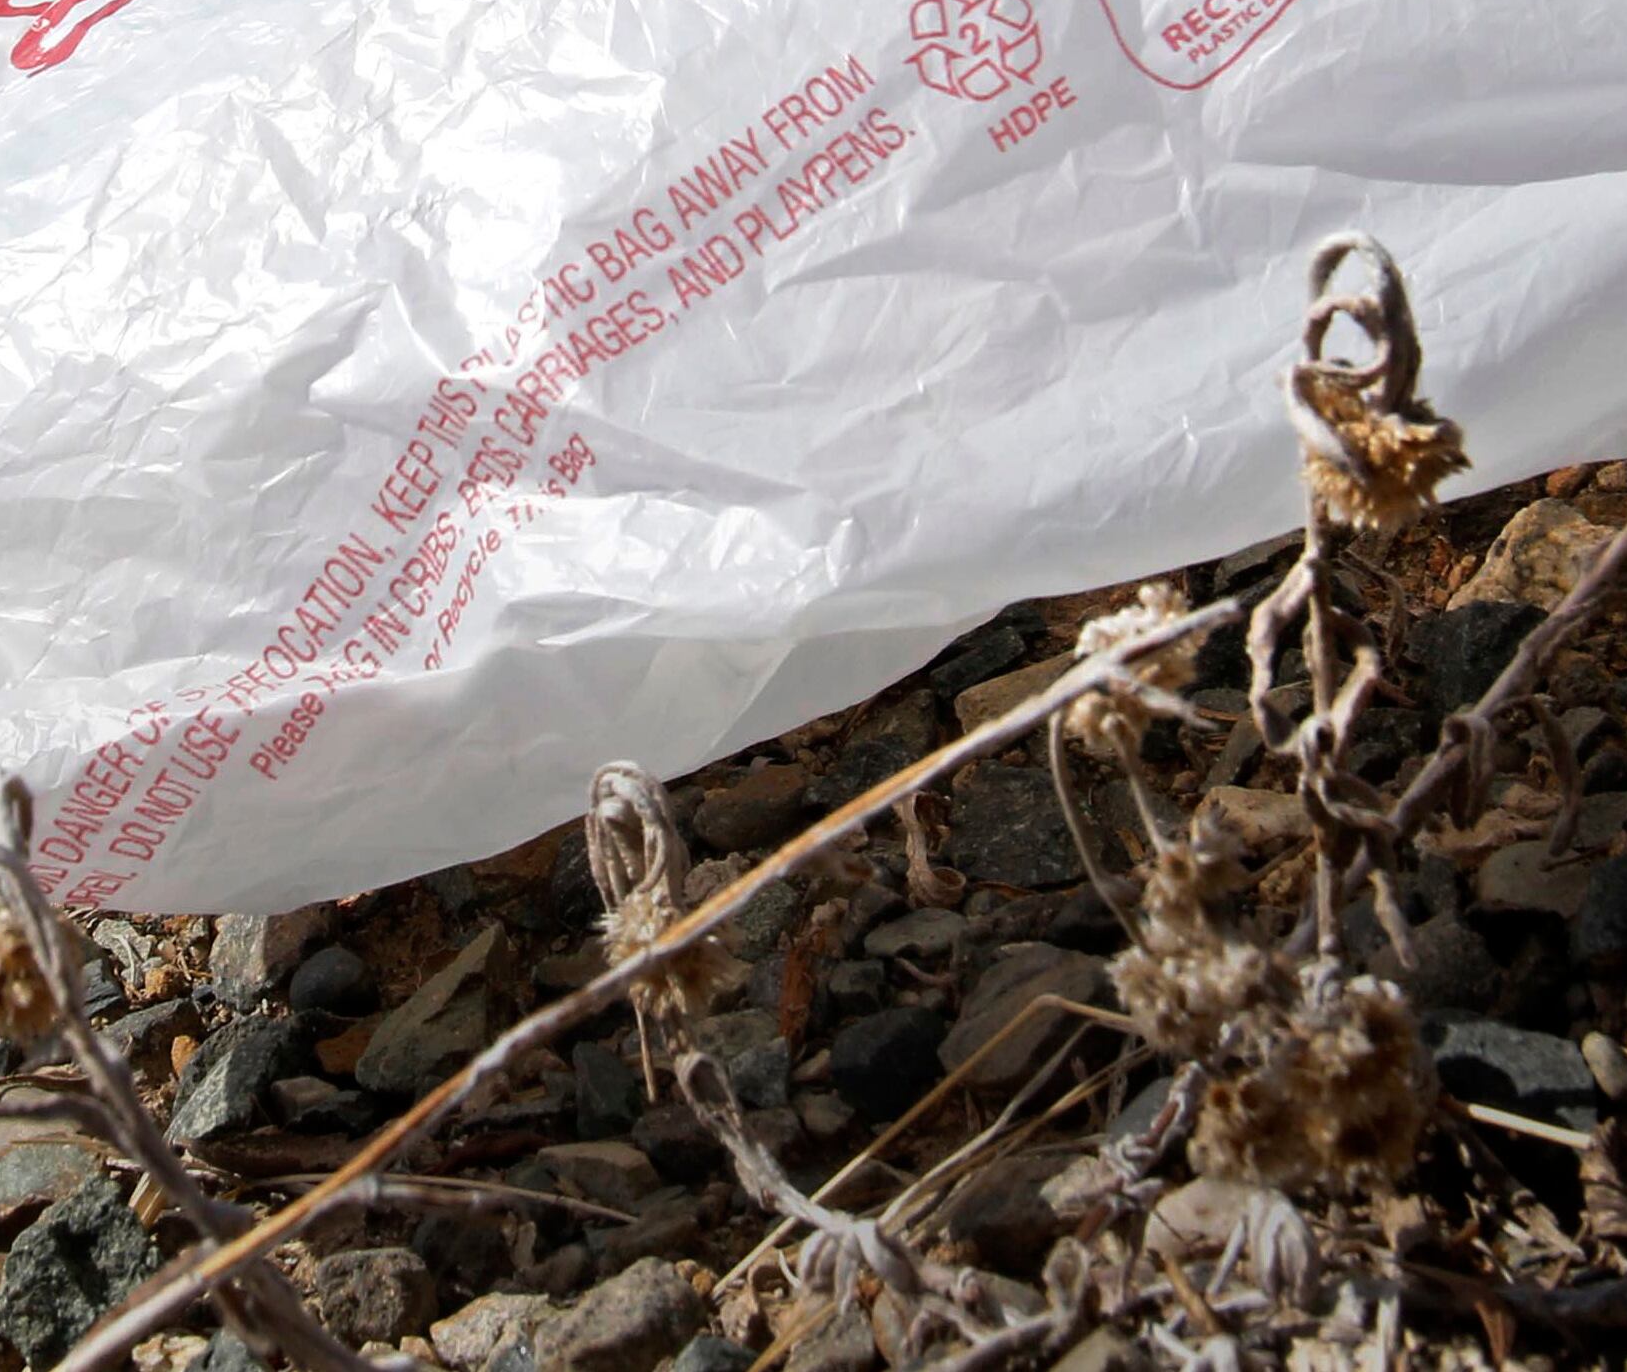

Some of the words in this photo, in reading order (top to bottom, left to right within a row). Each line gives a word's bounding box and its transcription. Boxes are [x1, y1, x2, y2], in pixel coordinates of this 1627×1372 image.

[958, 22, 992, 56] 2
[1187, 6, 1261, 63] PLASTIC
[986, 76, 1079, 154] HDPE
[734, 106, 917, 258] PLAYPENS.
[667, 234, 745, 310] AND
[493, 289, 680, 447] CARRIAGES,
[39, 740, 144, 864] DANGER
[371, 439, 443, 535] KEEP
[417, 377, 477, 450] THIS
[586, 208, 676, 283] BAG
[667, 126, 770, 231] AWAY
[762, 53, 876, 151] FROM
[249, 692, 325, 781] Please
[437, 529, 502, 646] Recycle
[548, 432, 597, 485] Bag
[362, 602, 411, 656] IN
[170, 705, 242, 781] USE
[133, 766, 201, 826] NOT
[108, 821, 166, 862] DO
